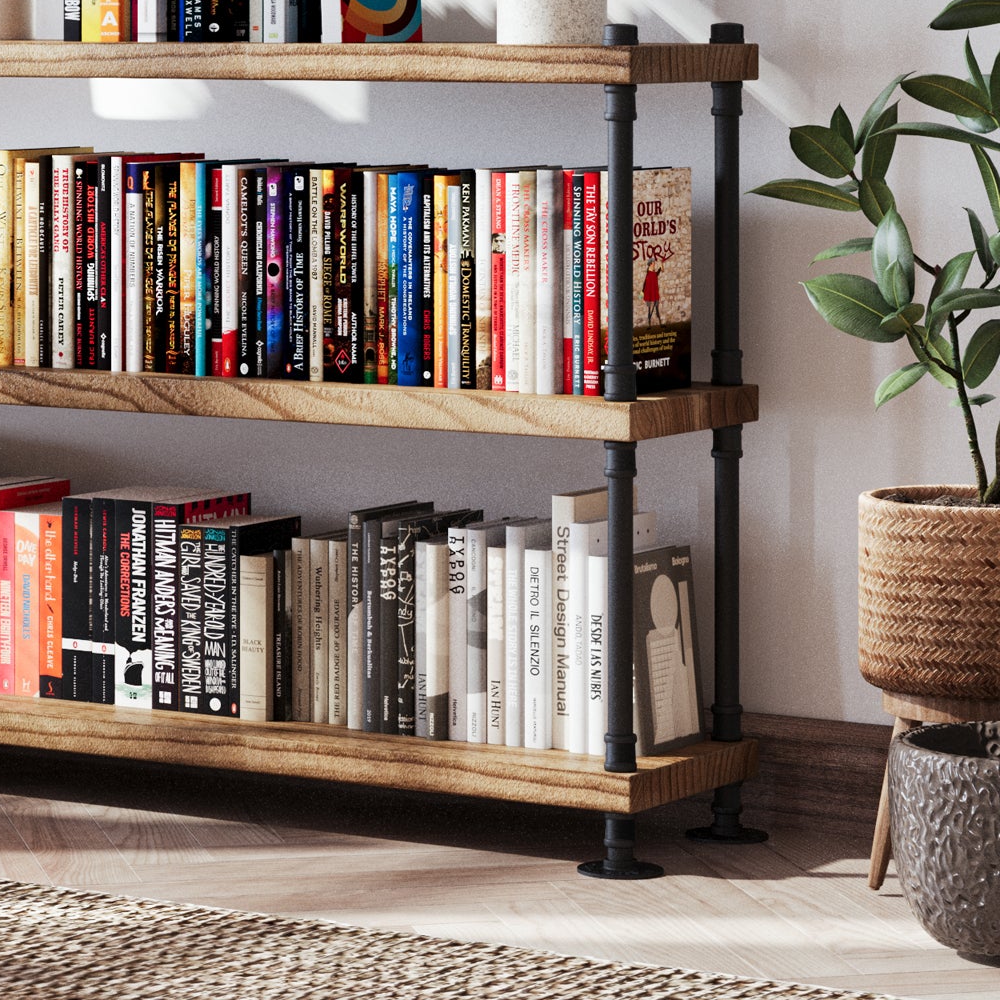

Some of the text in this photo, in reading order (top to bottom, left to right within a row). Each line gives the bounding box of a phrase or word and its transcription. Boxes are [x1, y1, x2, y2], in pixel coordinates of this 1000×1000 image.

[311, 207, 317, 218] ON
[351, 220, 357, 229] OF
[573, 186, 582, 237] SPINNING
[637, 201, 662, 217] OUR
[294, 252, 304, 277] TIME
[323, 257, 332, 286] SIEGE
[402, 253, 407, 262] OF
[573, 241, 582, 278] WORLD
[294, 278, 304, 290] OF
[461, 184, 471, 379] KEN PAKMAN DOMESTIC TRANQUILITY
[294, 294, 304, 330] HISTORY
[323, 294, 332, 324] ROME
[573, 281, 582, 325] HISTORY
[294, 334, 304, 359] BRIEF
[645, 357, 670, 369] BURNETT
[45, 530, 57, 547] the
[154, 519, 176, 568] HITMAN
[45, 548, 57, 573] other
[120, 532, 130, 616] THE CORRECTIONS
[132, 508, 146, 642] JONATHAN FRANZEN
[45, 575, 57, 601] hand
[154, 570, 176, 615] ANDERS
[23, 573, 31, 640] DAVID NICHOLLS
[314, 567, 323, 650] Wuthering Heights
[530, 566, 540, 676] DIETRO IL SILENZIO
[554, 526, 570, 716] Street Design Manual
[154, 617, 176, 669] MEANING
[491, 680, 501, 729] IAN HUNT
